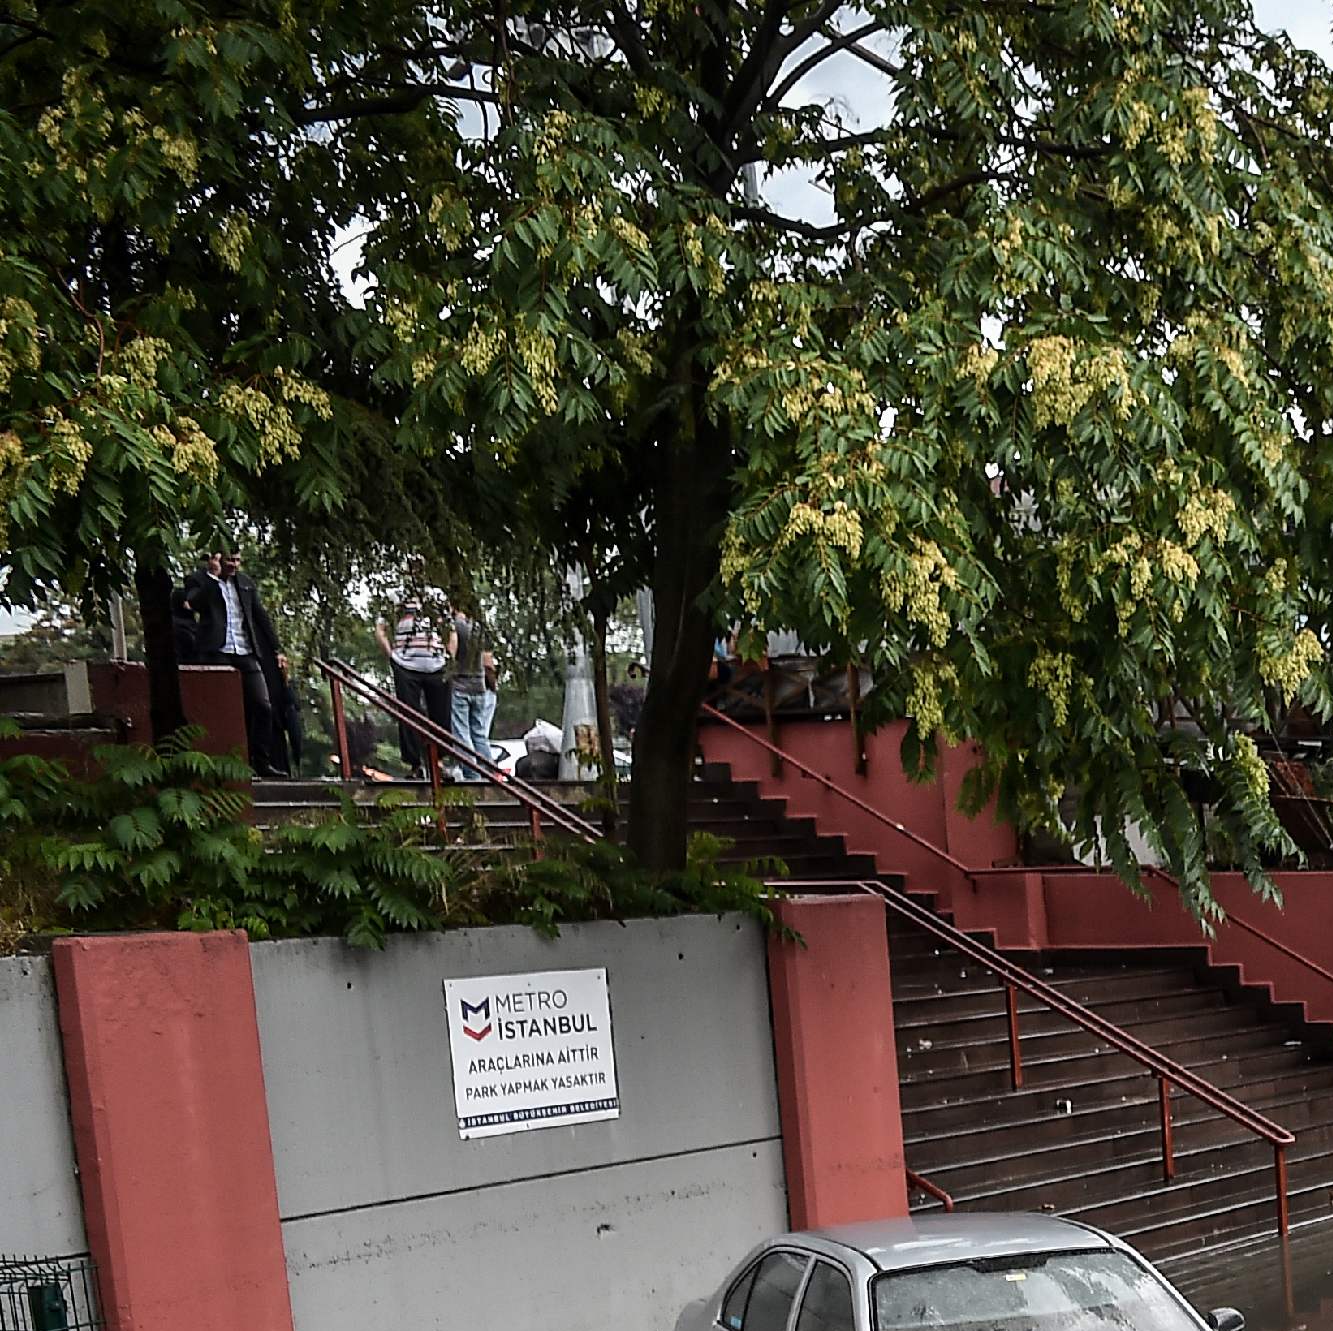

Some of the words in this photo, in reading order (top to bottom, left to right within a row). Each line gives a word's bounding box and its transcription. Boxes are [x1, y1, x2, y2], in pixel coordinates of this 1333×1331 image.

[494, 989, 568, 1014] METRO
[497, 1013, 598, 1040] İSTANBUL
[468, 1051, 555, 1076] ARAÇLARINA
[557, 1044, 600, 1064] AİTTİR
[465, 1084, 499, 1100] PARK
[501, 1078, 549, 1096] YAPMAK
[551, 1072, 606, 1090] YASAKTIR
